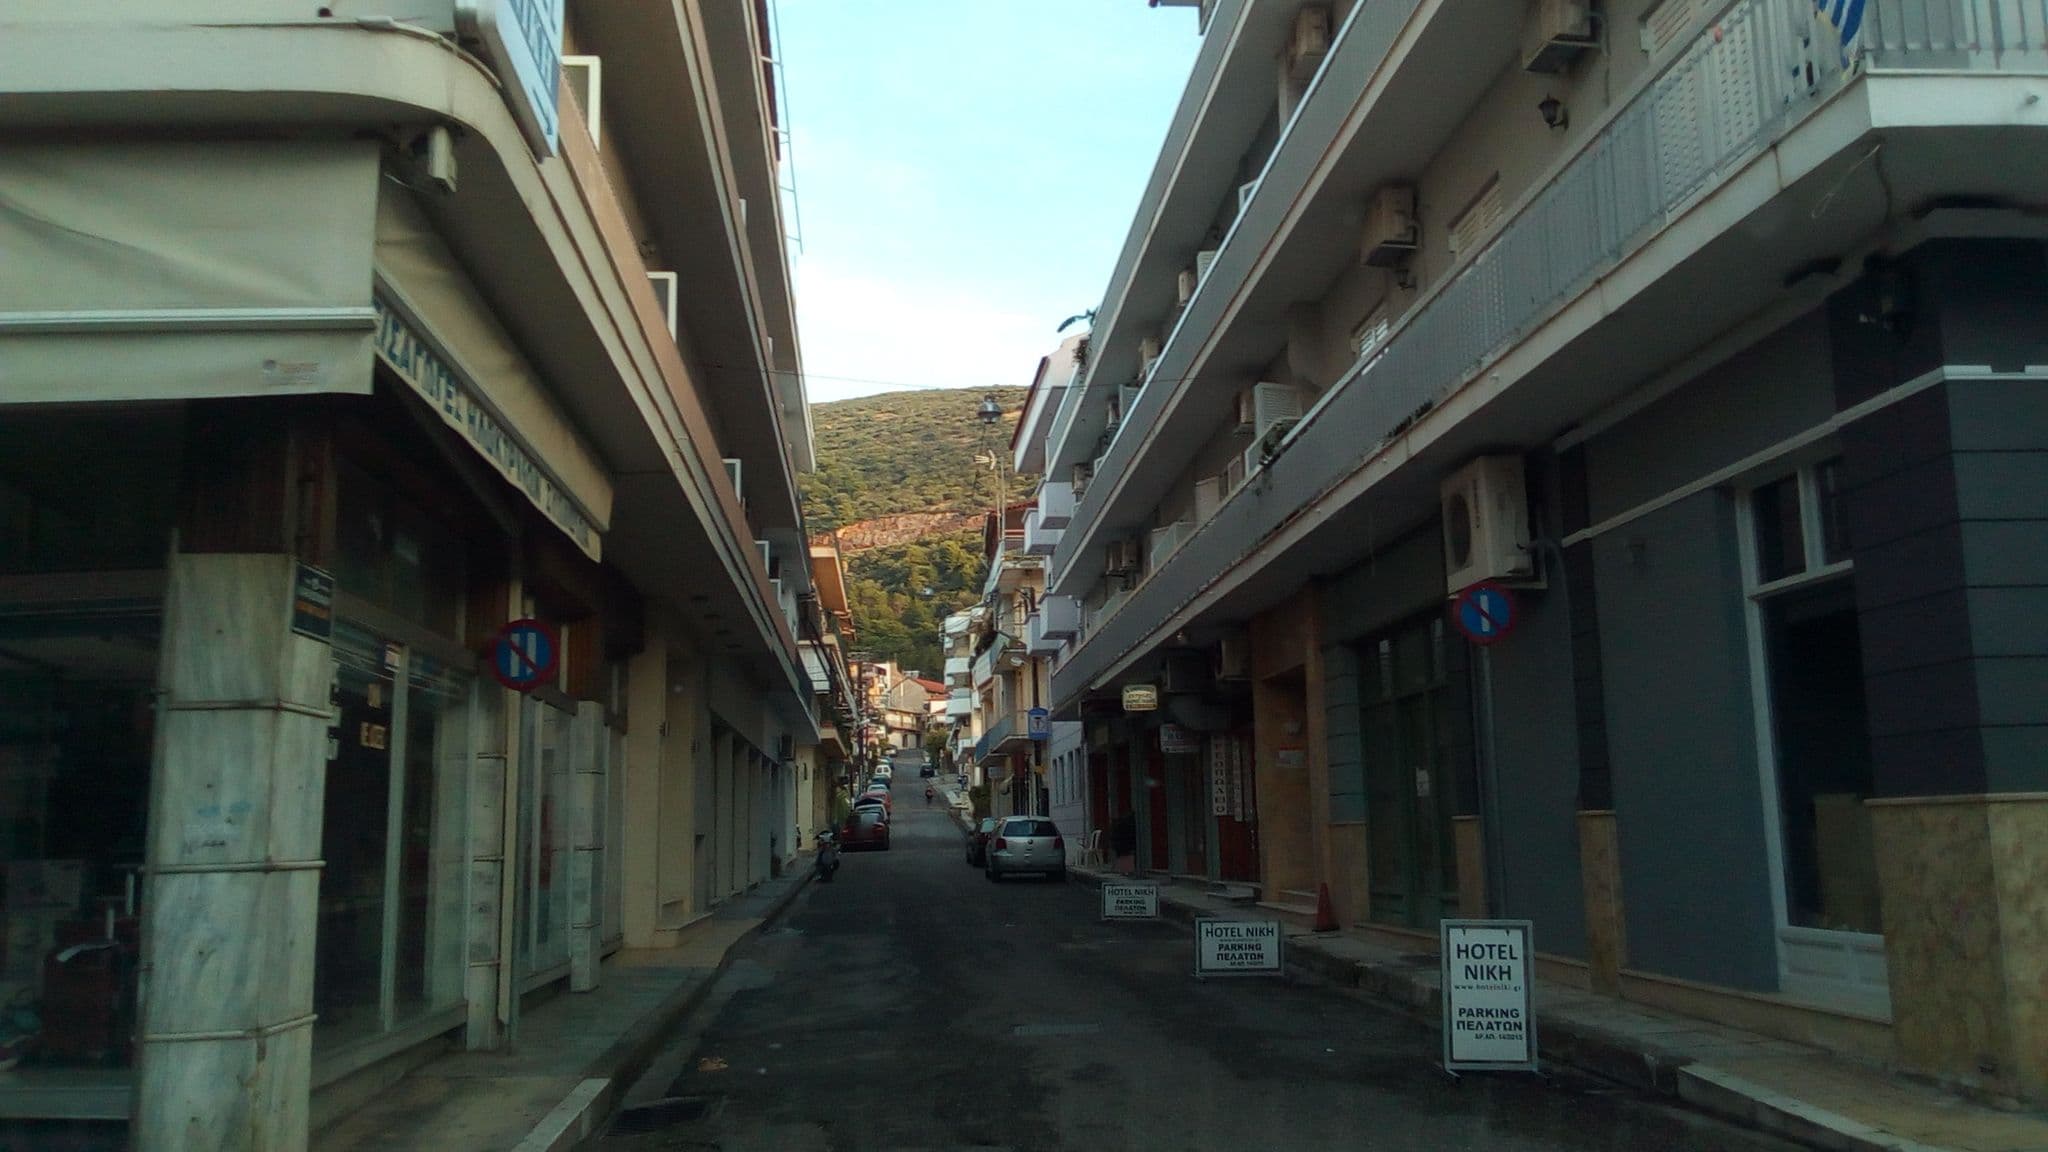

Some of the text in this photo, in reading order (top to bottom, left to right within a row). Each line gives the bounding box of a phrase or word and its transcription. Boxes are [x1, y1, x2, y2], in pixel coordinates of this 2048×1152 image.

[1107, 888, 1132, 896] HOTEL
[1205, 927, 1242, 938] HOTEL
[1218, 943, 1262, 951] PARKING
[1456, 943, 1518, 960] HOTEL
[1216, 952, 1264, 961] ΠΕΛΑΤΩΝ
[1458, 1007, 1520, 1019] PARKING
[1456, 1020, 1523, 1032] ΠΕΛΑΤΩΝ
